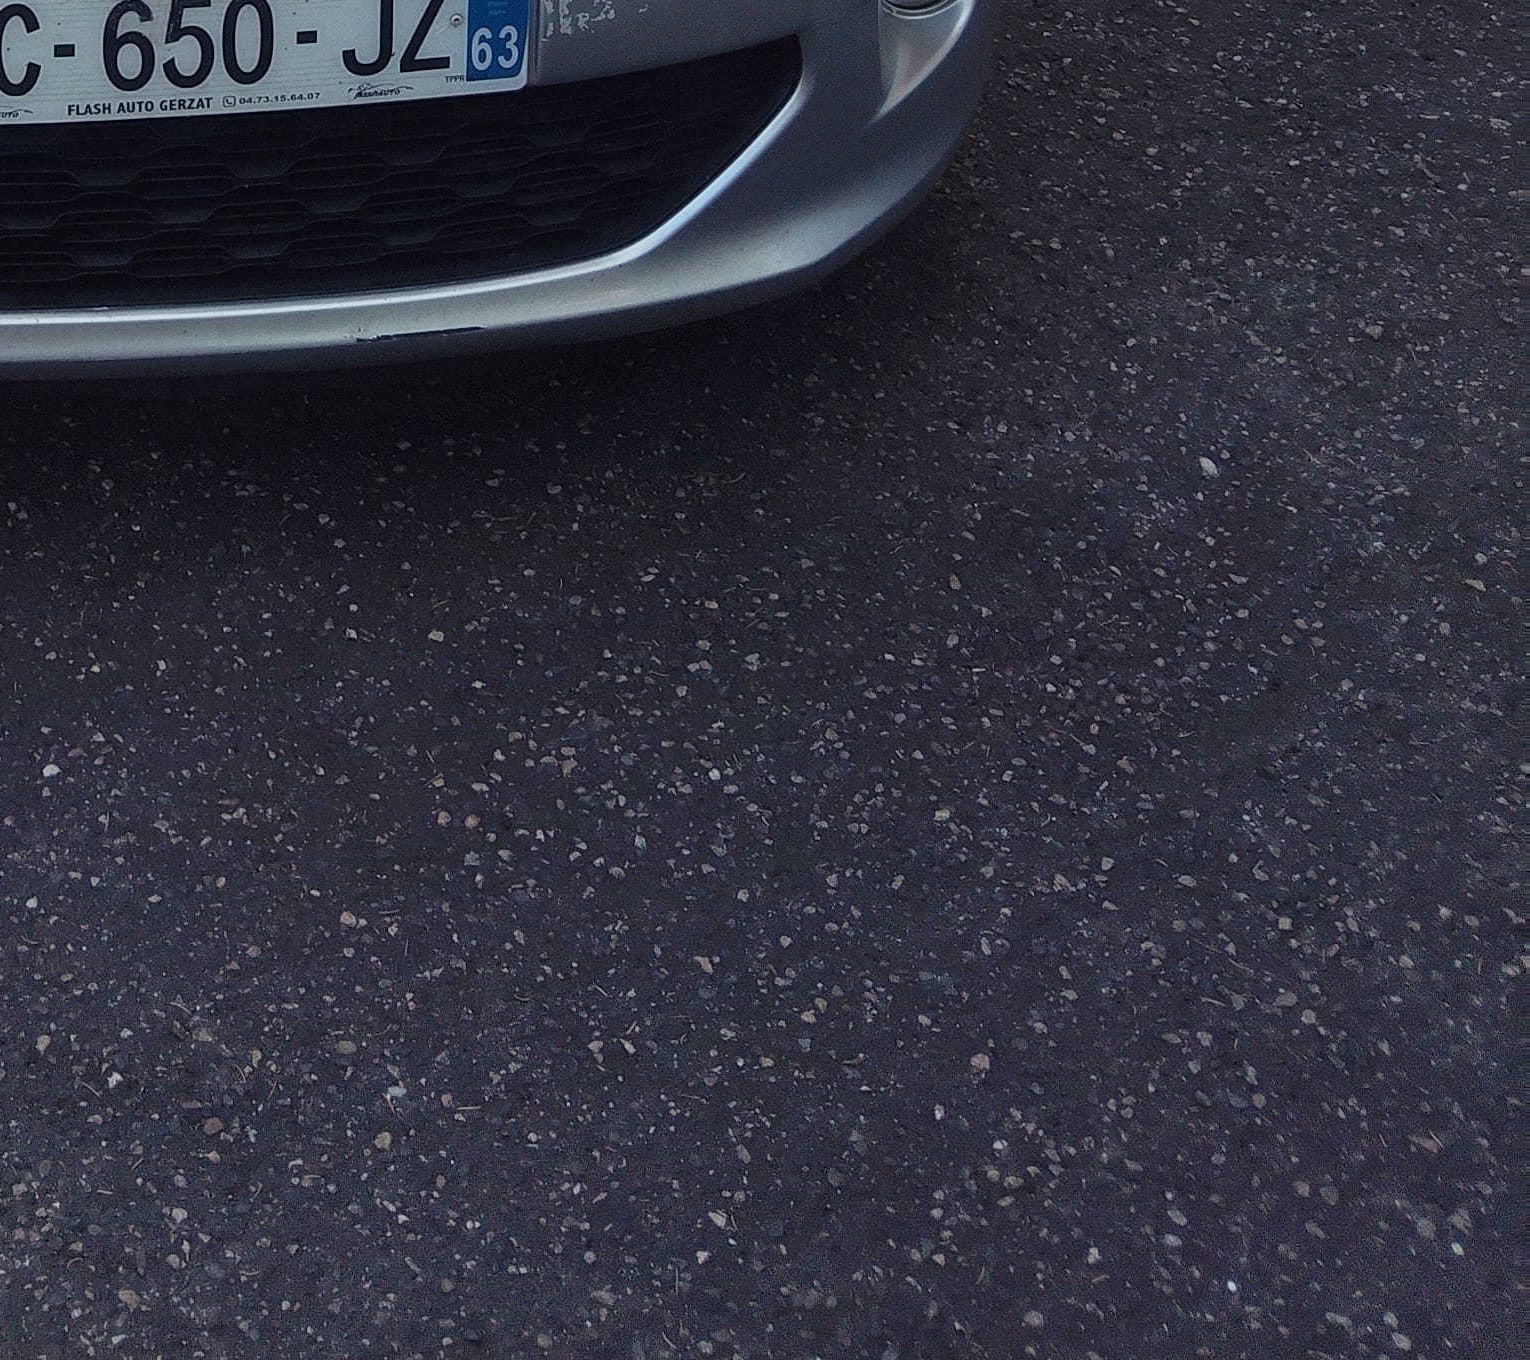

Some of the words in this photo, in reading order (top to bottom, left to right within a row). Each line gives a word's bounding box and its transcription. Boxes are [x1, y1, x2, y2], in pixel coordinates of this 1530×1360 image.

[471, 24, 519, 71] 63
[67, 102, 112, 117] FLASH
[116, 100, 155, 114] AUTO
[159, 96, 214, 112] GERZAT
